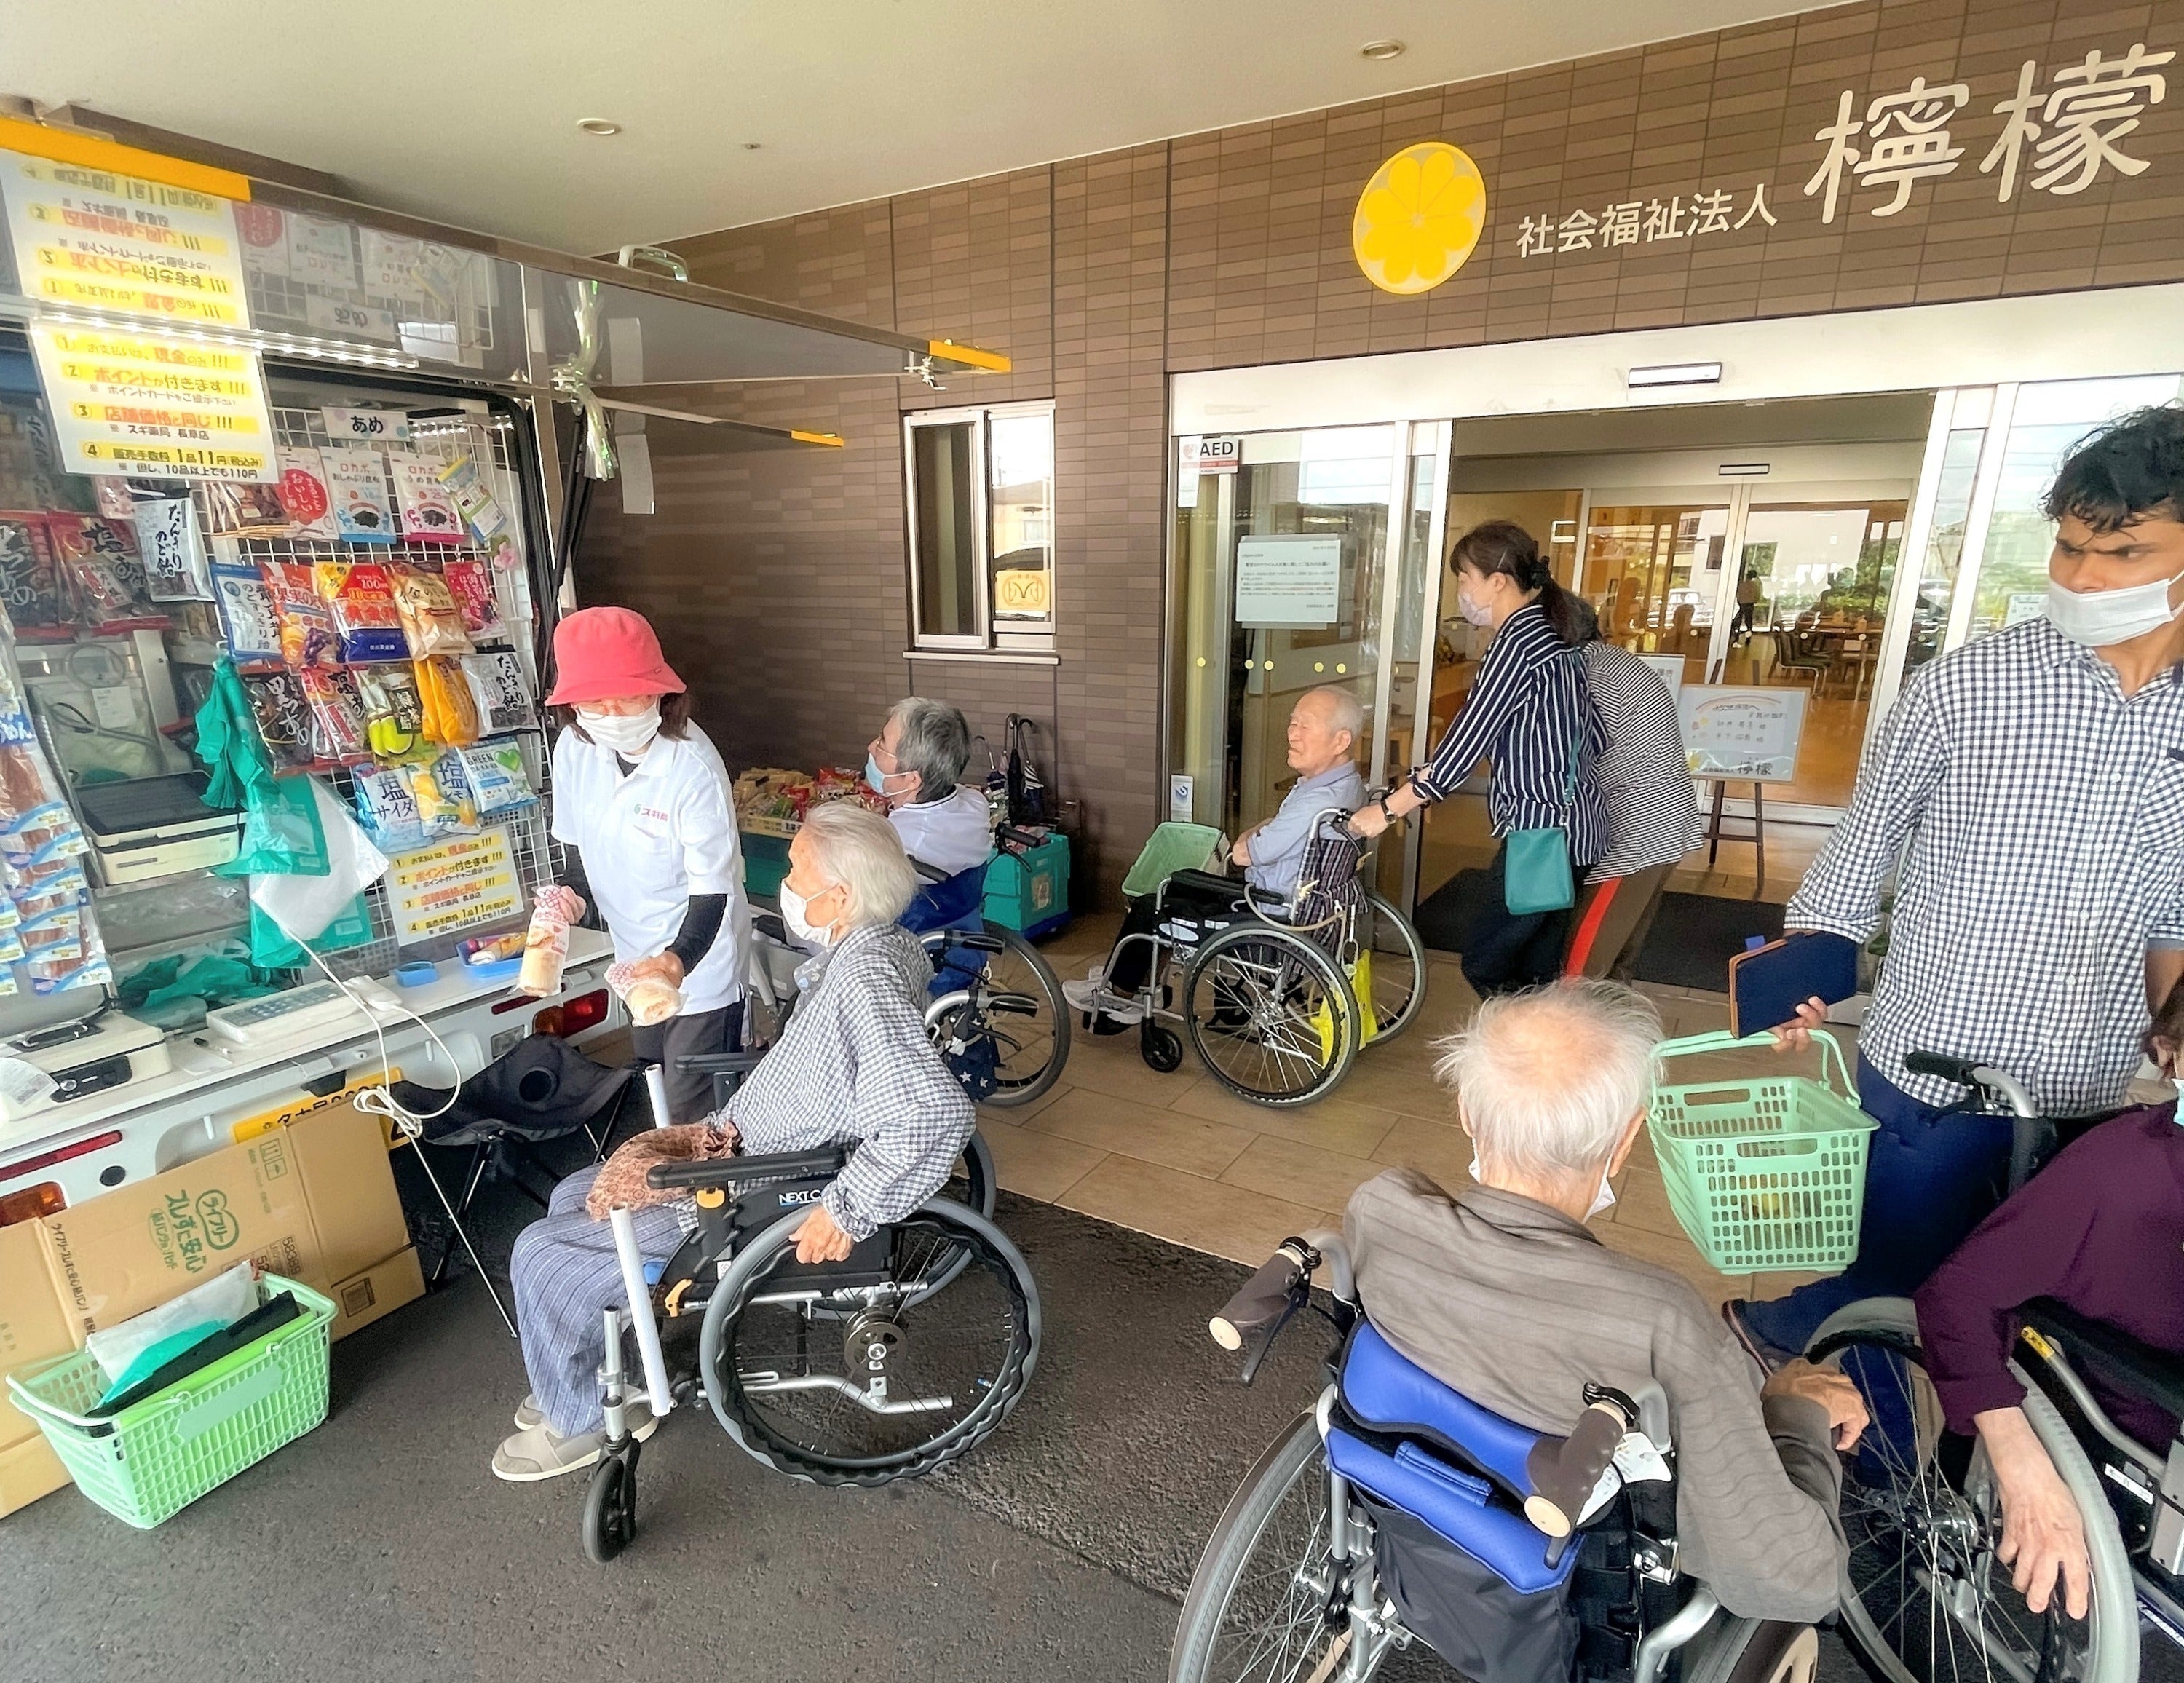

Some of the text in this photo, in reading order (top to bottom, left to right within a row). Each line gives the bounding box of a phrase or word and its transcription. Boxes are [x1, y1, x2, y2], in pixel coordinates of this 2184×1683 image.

[1516, 44, 2176, 258] 社会福祉法人 檸檬
[350, 415, 384, 433] あめ
[1200, 441, 1233, 456] AED
[466, 753, 494, 765] GREEN
[438, 761, 464, 790] 塩
[378, 775, 409, 801] 塩
[376, 799, 417, 820] サイダ
[778, 1191, 809, 1203] NEXT
[202, 1197, 228, 1243] ライフリー
